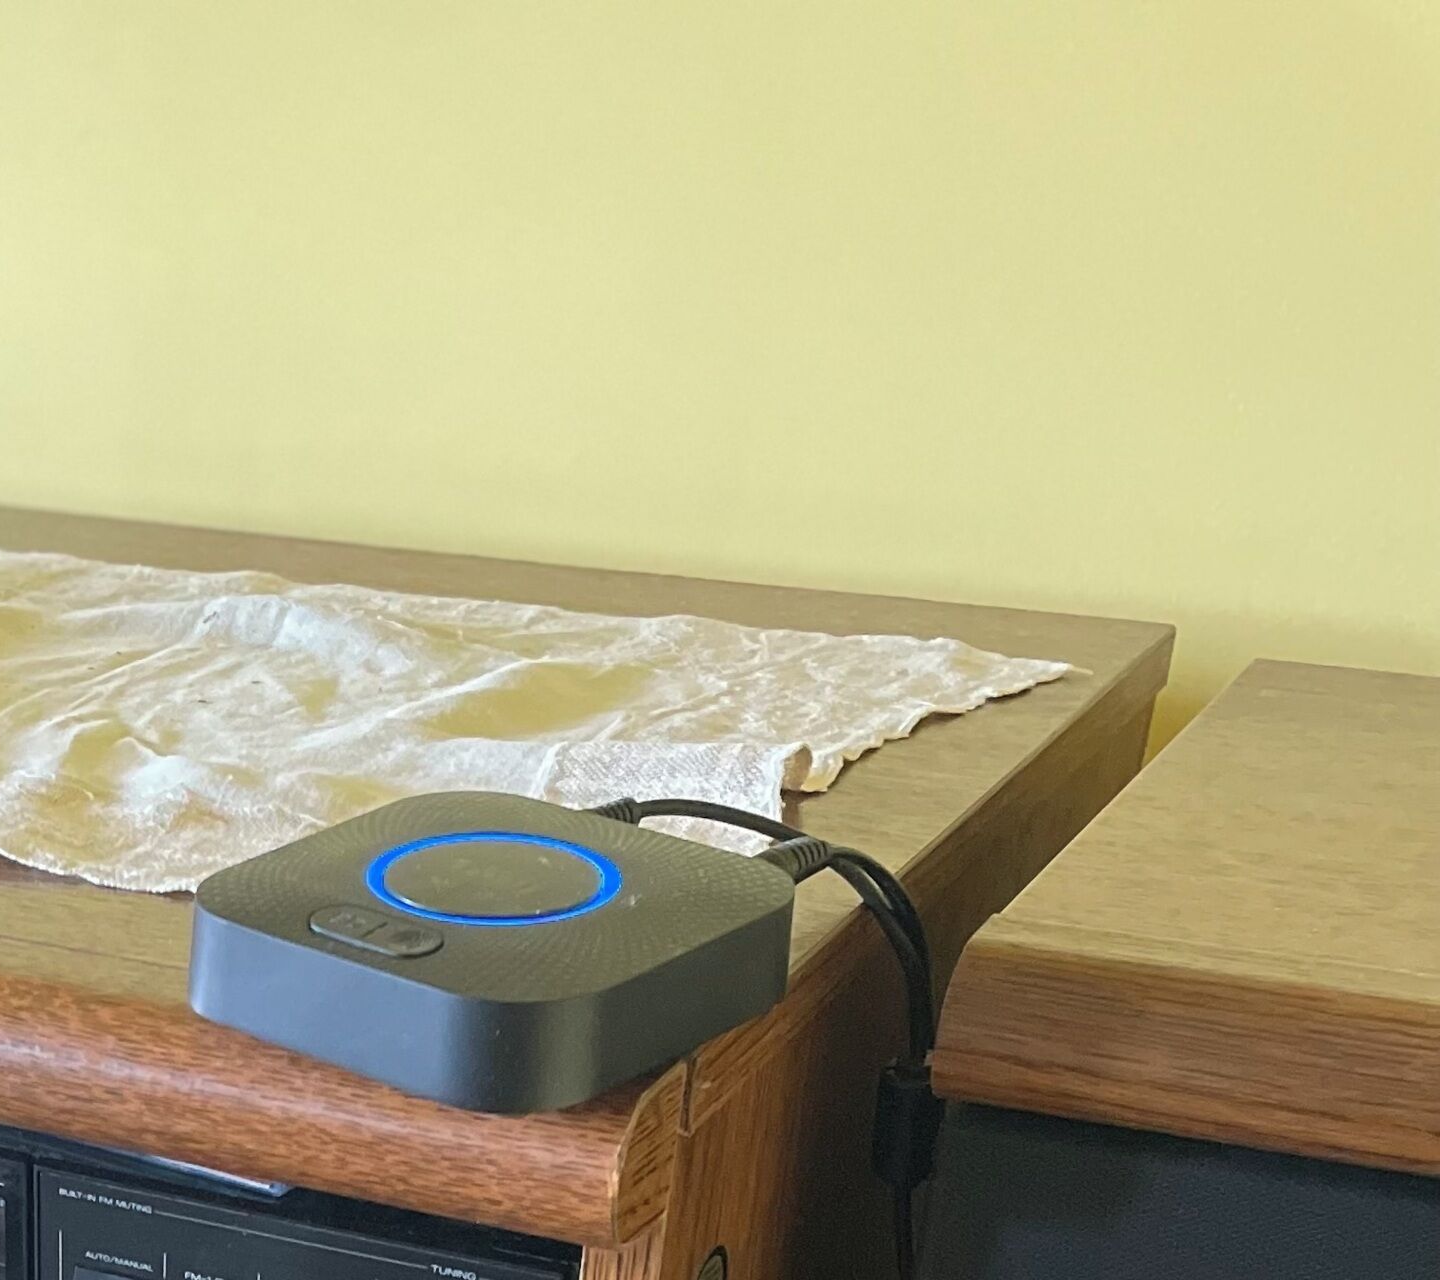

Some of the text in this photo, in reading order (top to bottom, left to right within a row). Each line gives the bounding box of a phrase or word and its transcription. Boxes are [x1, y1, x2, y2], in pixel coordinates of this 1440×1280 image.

[99, 1194, 113, 1206] FM
[115, 1198, 154, 1215] MUTING
[85, 1250, 155, 1273] AUTO/MANUAL
